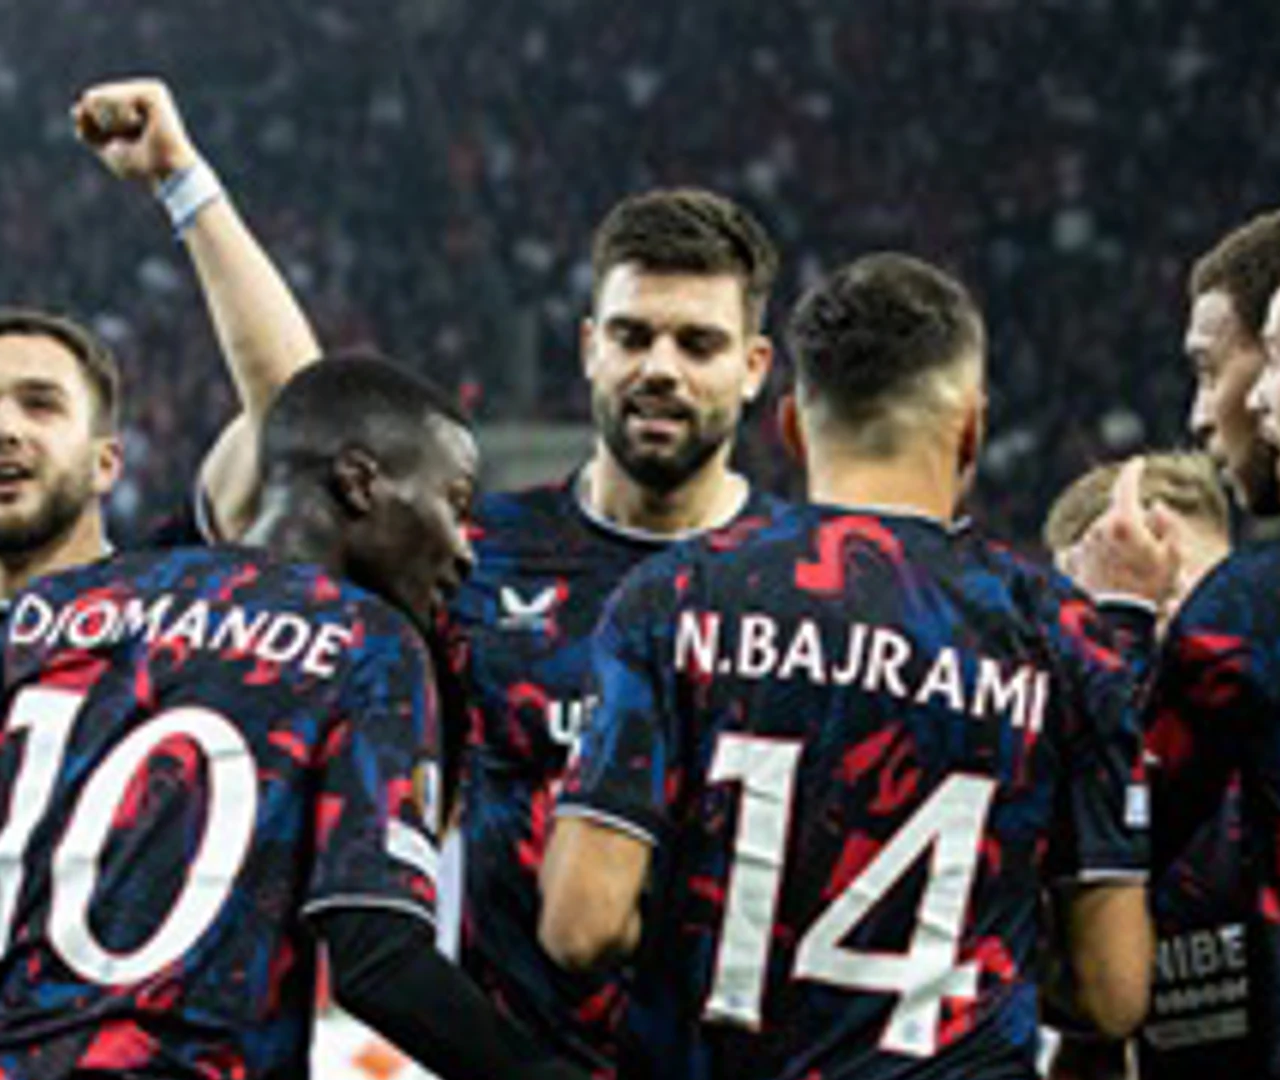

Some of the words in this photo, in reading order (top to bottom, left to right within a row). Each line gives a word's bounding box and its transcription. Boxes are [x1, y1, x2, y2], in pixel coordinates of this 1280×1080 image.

[9, 593, 354, 678] DIOMANDE
[673, 610, 1049, 732] N.BAJRAMI
[702, 733, 998, 1057] 14
